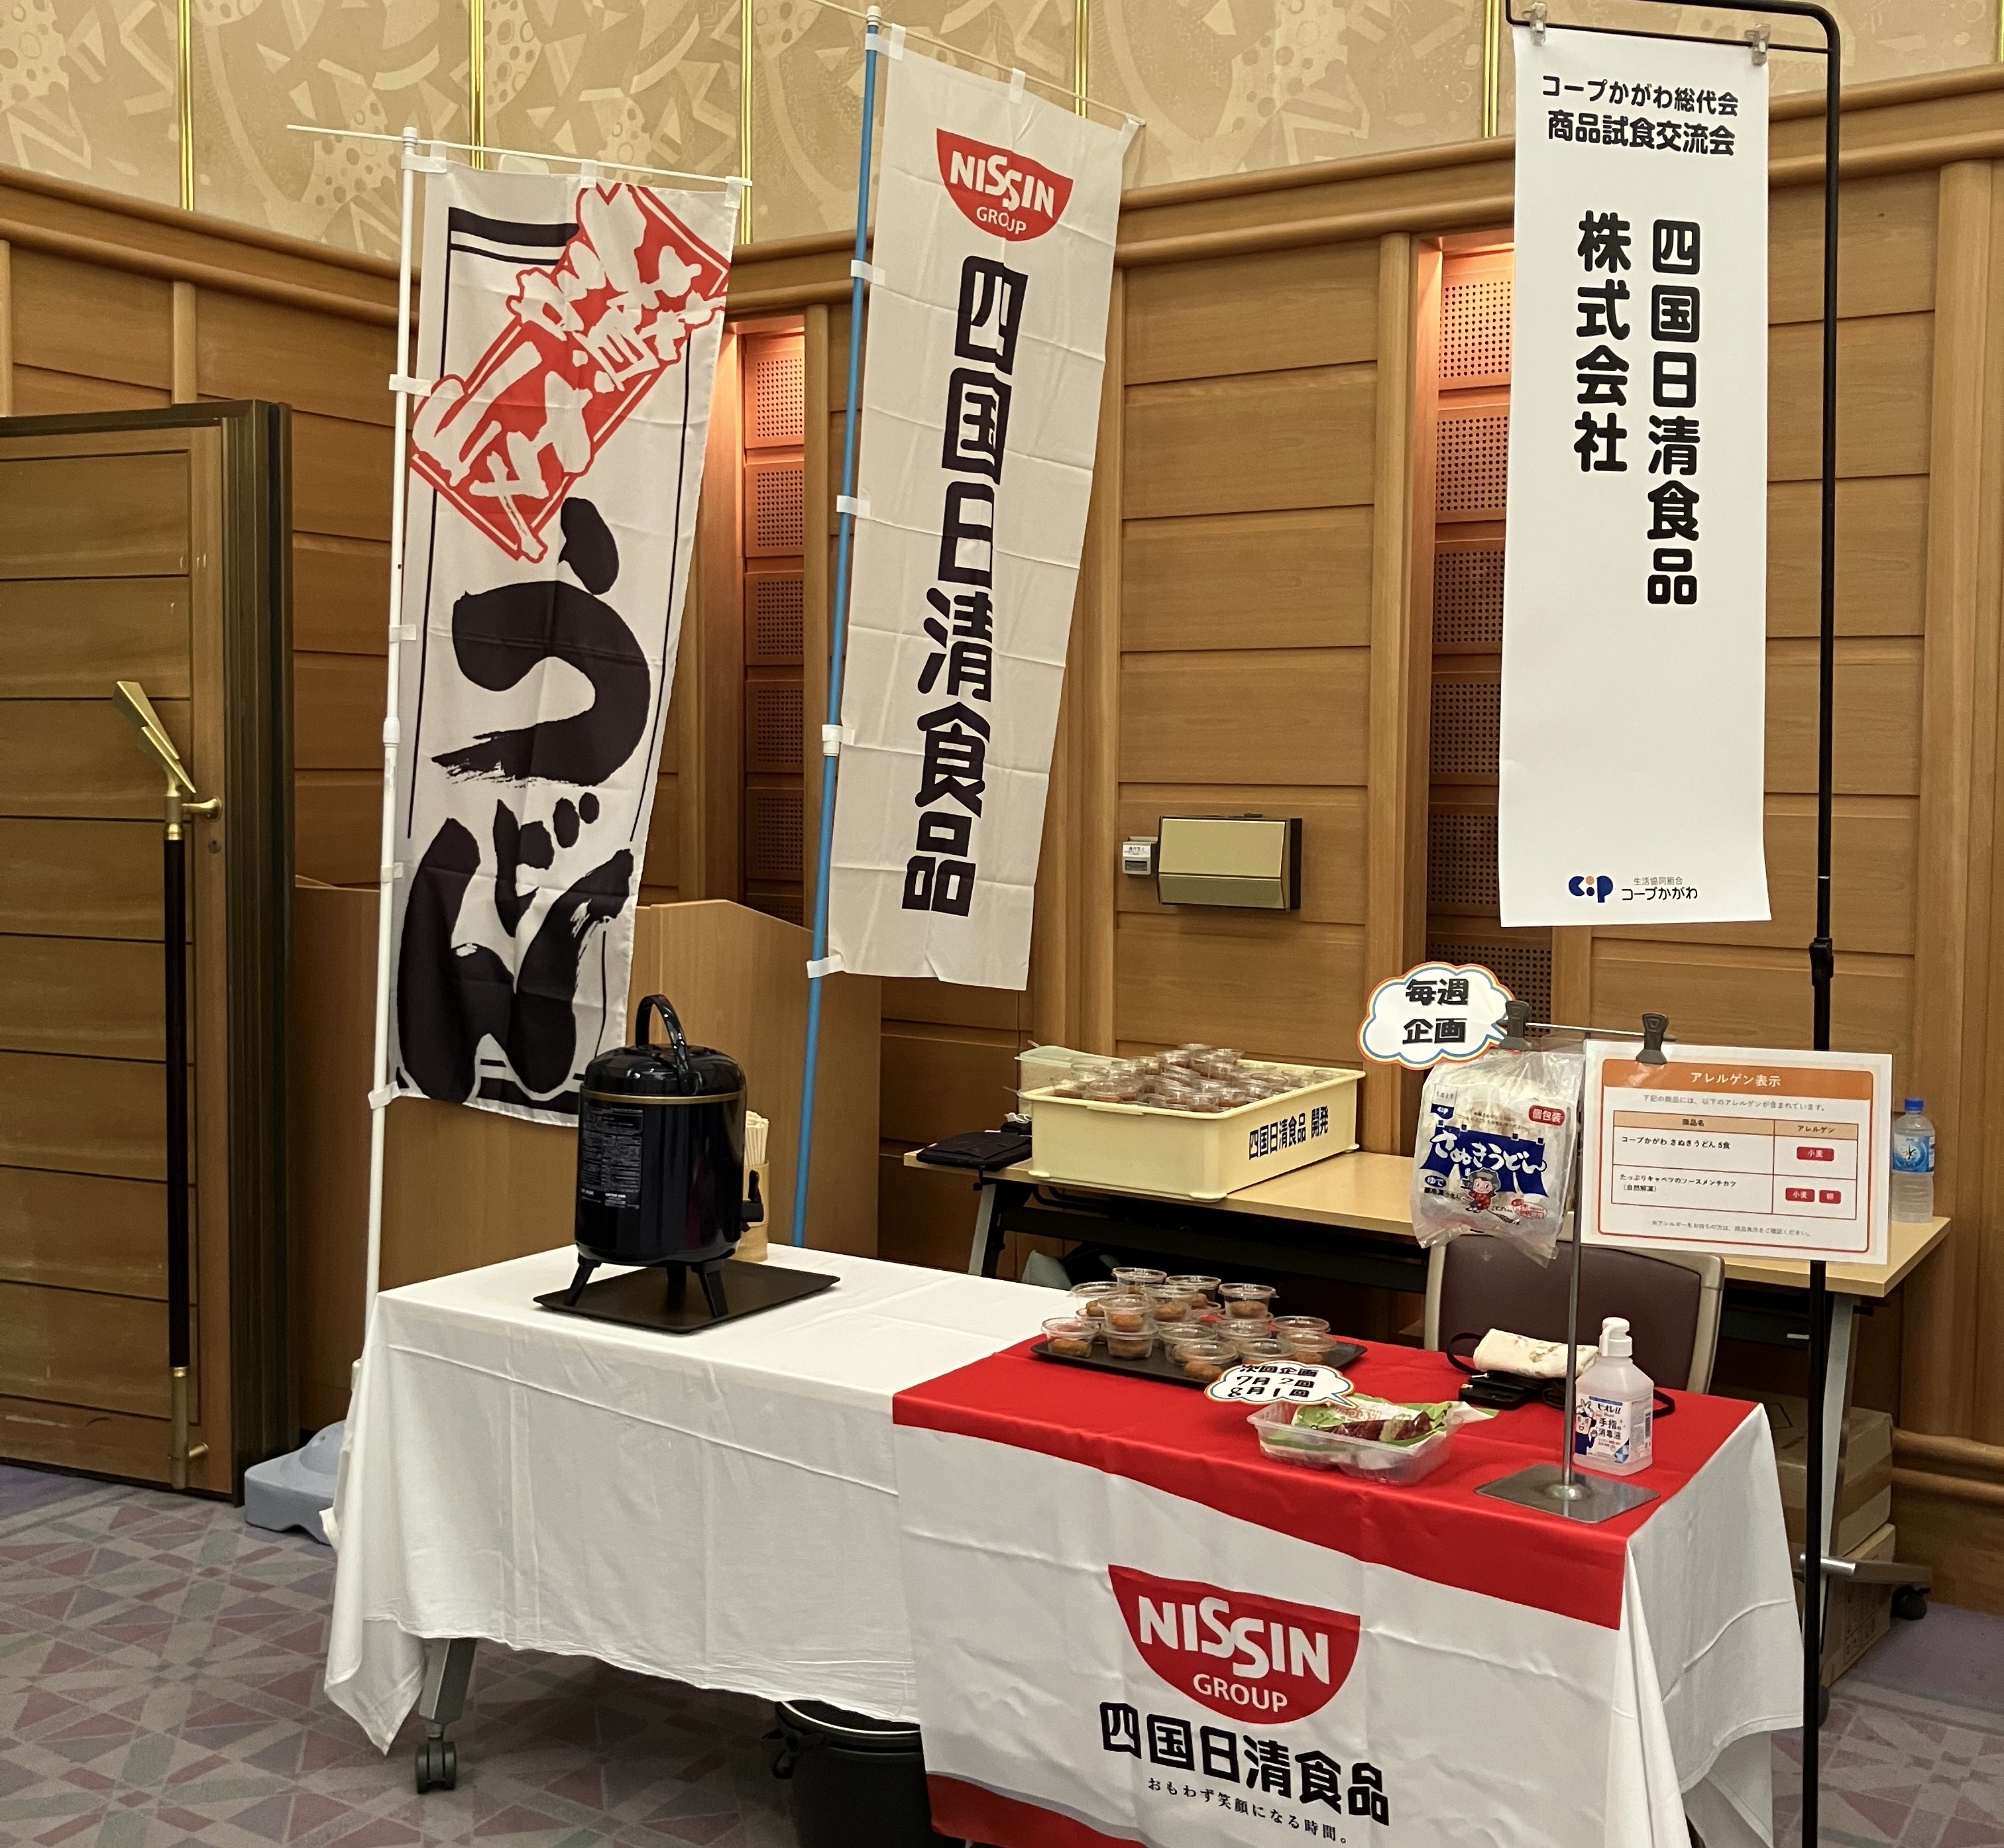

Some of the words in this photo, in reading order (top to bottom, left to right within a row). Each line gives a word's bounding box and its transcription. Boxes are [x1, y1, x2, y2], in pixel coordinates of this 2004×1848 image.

[1542, 75, 1739, 117] コープかがわ総代会
[1547, 109, 1736, 156] 商品試食交流会
[949, 150, 1055, 219] NISSIN
[1573, 209, 1632, 472] 株式会社
[1647, 219, 1700, 606] 四国日清食品
[901, 254, 1029, 917] 四国日清食品
[396, 496, 651, 1105] うどん
[1621, 886, 1698, 900] コープかがわ
[1634, 876, 1683, 886] 生活協同組合
[1405, 978, 1469, 1006] 毎週
[1402, 1018, 1468, 1045] 企画
[1691, 1071, 1781, 1087] アレルゲン表示
[1249, 1113, 1306, 1160] 四国日清食品
[1311, 1105, 1329, 1139] 開発
[1429, 1129, 1547, 1174] さぬきうどん
[1622, 1136, 1667, 1146] コープかがわ
[1670, 1138, 1716, 1148] さぬきうどん
[1797, 1125, 1835, 1134] アレルゲン
[1239, 1364, 1319, 1378] 次回企画
[1138, 1596, 1331, 1685] NISSIN
[1193, 1673, 1288, 1713] GROUP
[1099, 1702, 1390, 1826] 四国日清食品
[1148, 1776, 1347, 1844] おもわず笑顔になる時間。
